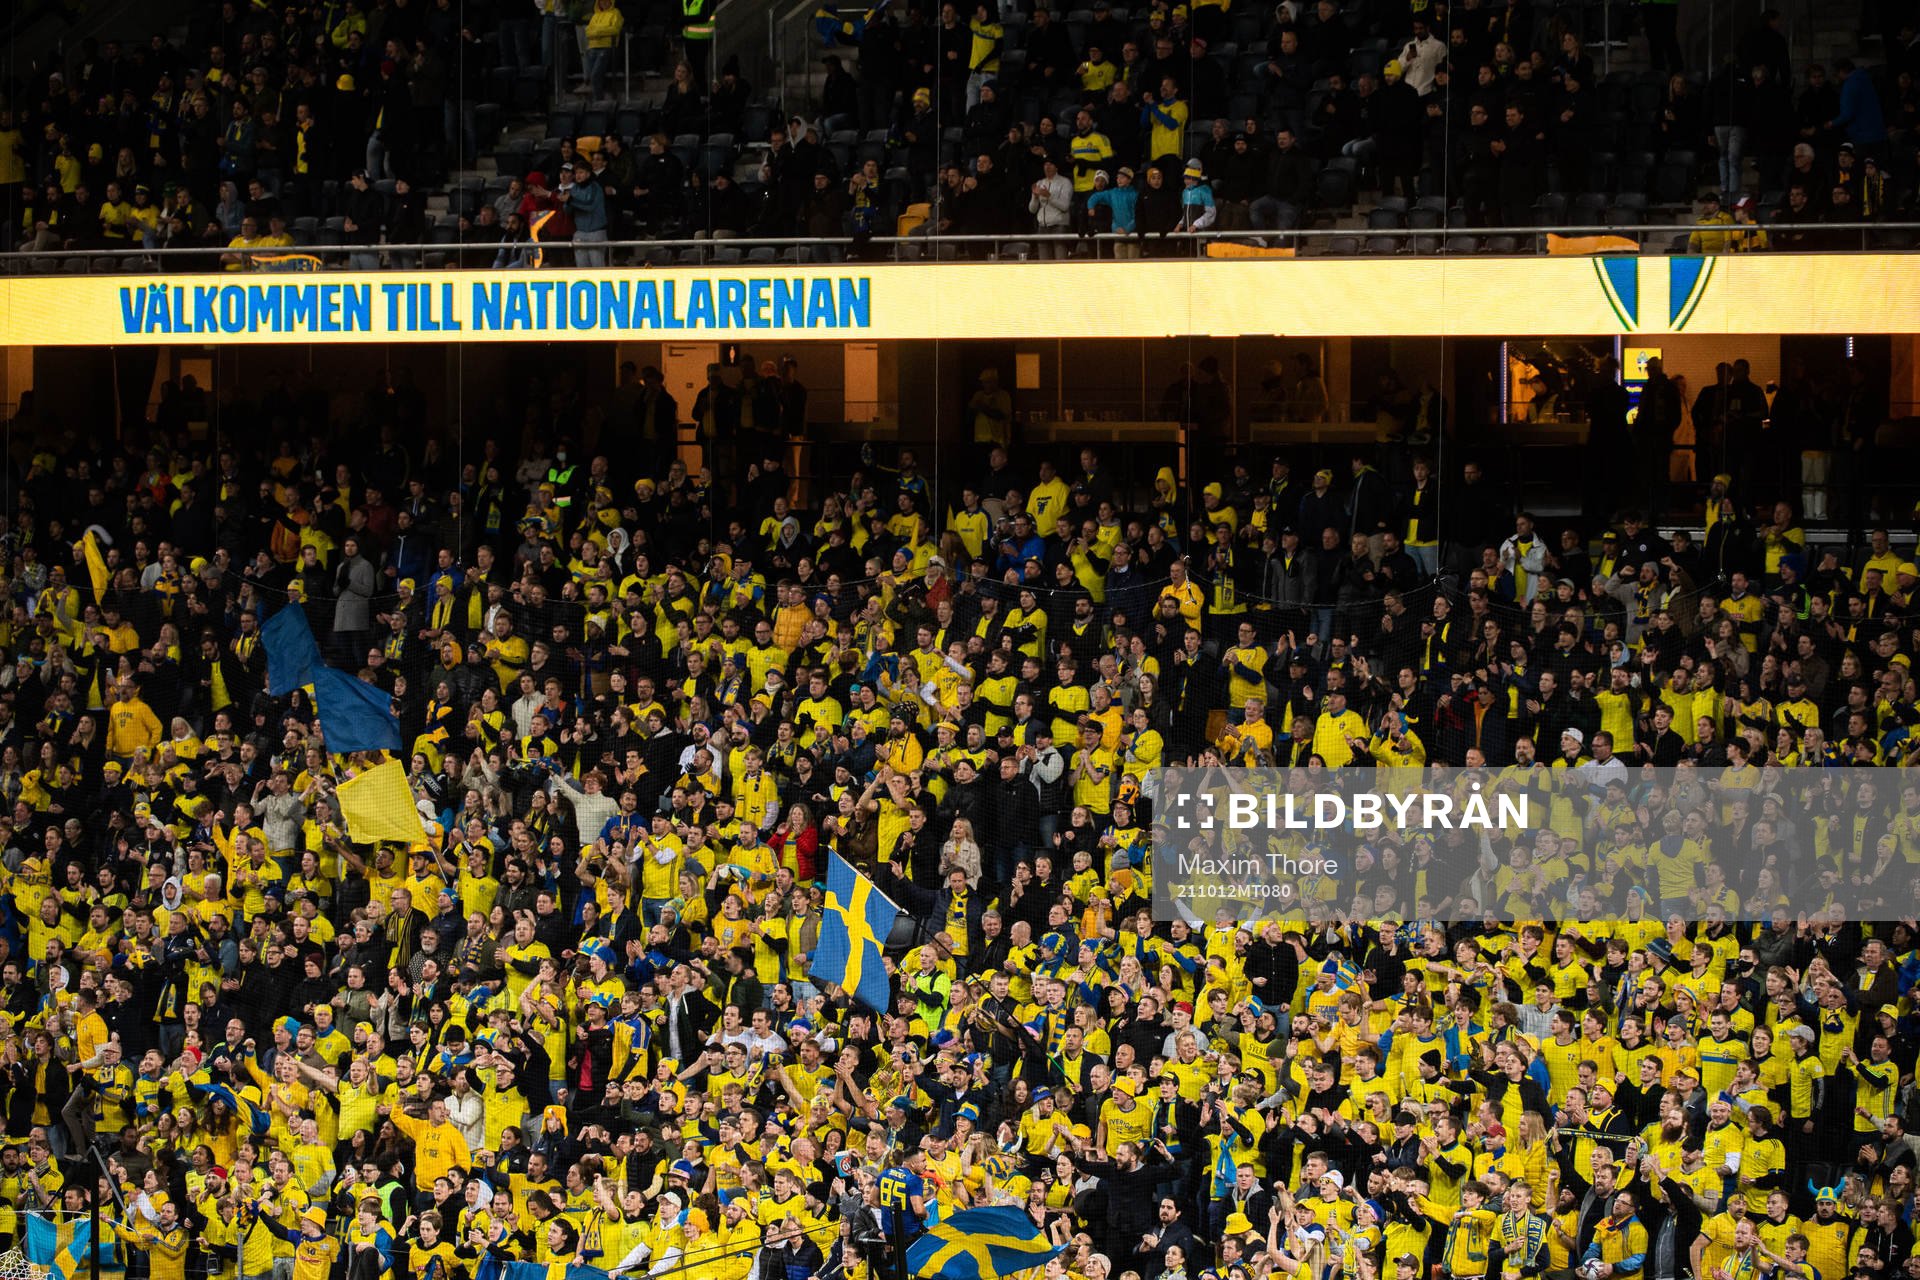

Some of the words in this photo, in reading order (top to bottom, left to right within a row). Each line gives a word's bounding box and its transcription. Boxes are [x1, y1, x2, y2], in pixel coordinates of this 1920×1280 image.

[120, 283, 371, 334] VÄLKOMMEN
[382, 283, 461, 331] TILL
[472, 277, 869, 331] NATIONALARENAN
[880, 1177, 906, 1210] 85
